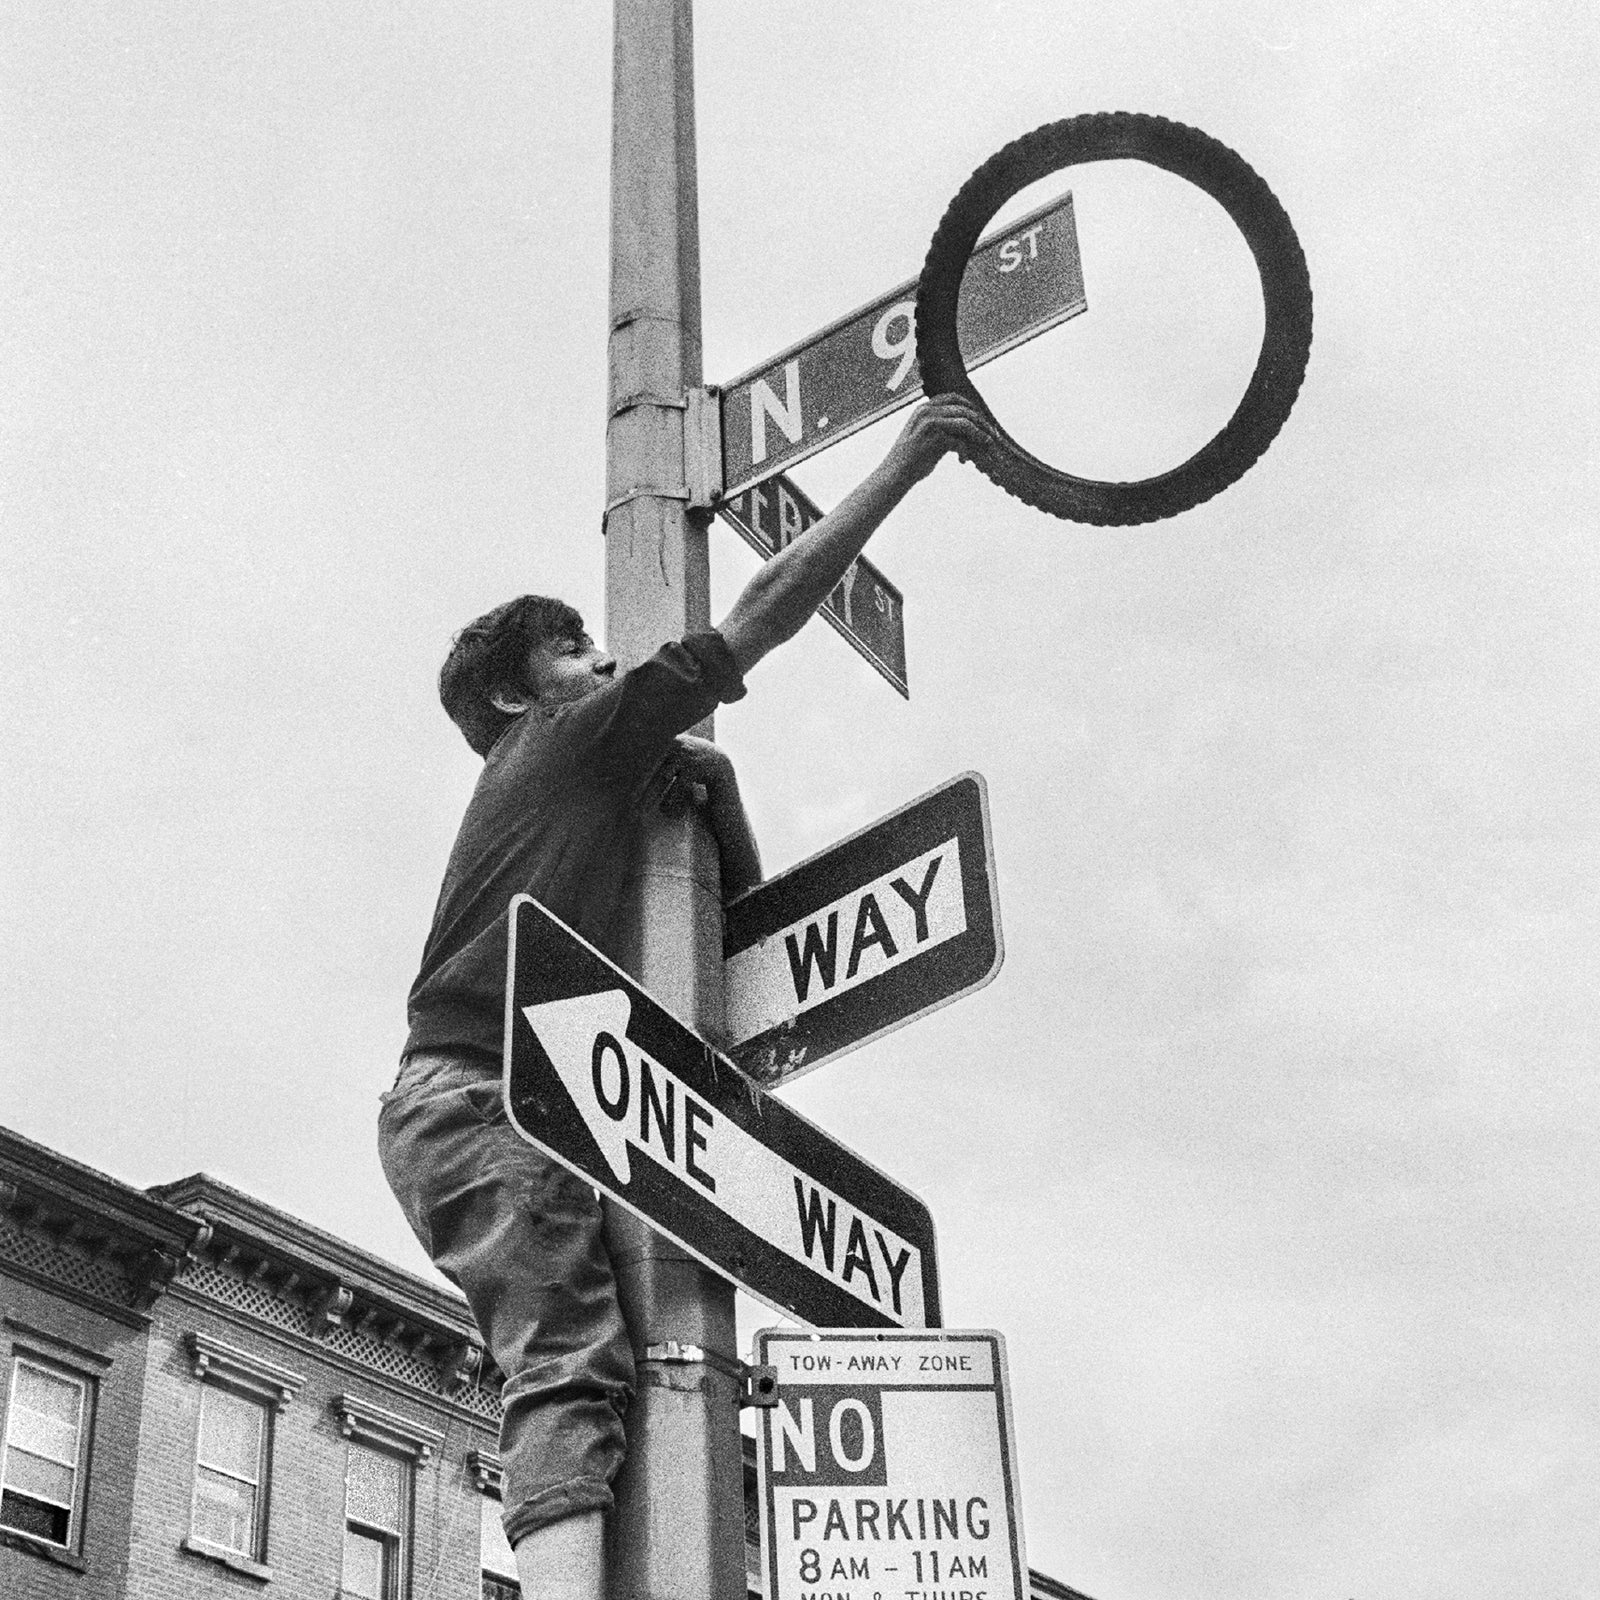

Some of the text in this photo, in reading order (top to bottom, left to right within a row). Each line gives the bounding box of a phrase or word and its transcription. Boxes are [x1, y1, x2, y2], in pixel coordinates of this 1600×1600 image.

[999, 225, 1043, 272] ST
[874, 584, 894, 621] ST
[785, 855, 943, 1004] WAY
[591, 1031, 911, 1316] ONE WAY
[790, 1355, 972, 1371] TOW-AWAY ZONE
[770, 1398, 874, 1472] NO
[792, 1497, 990, 1541] PARKING
